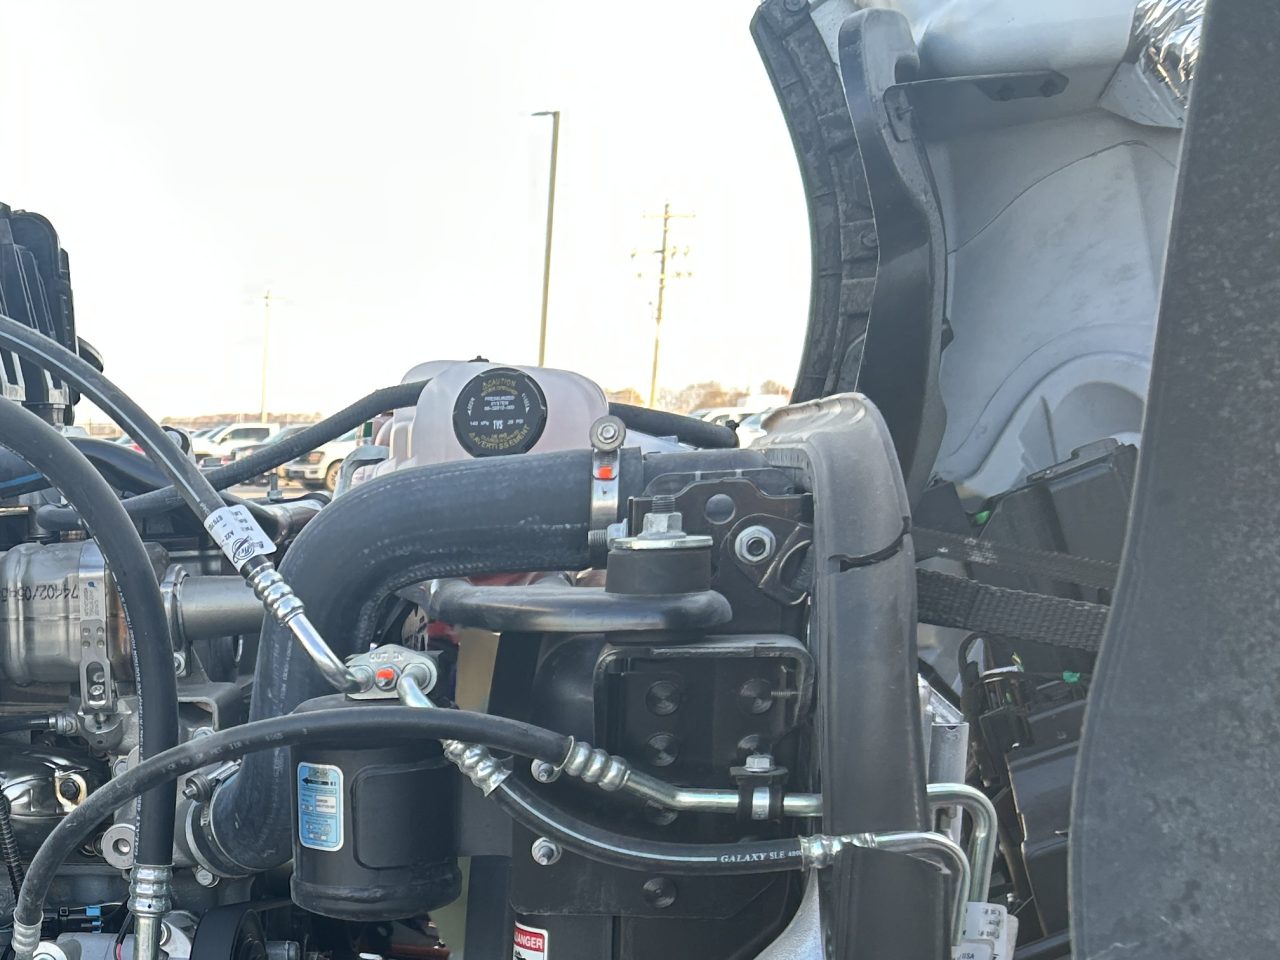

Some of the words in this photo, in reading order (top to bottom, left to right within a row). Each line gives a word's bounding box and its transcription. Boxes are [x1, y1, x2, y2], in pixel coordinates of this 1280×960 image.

[488, 378, 517, 387] CAUTION
[720, 852, 768, 863] GALAXY
[769, 851, 785, 860] SLE
